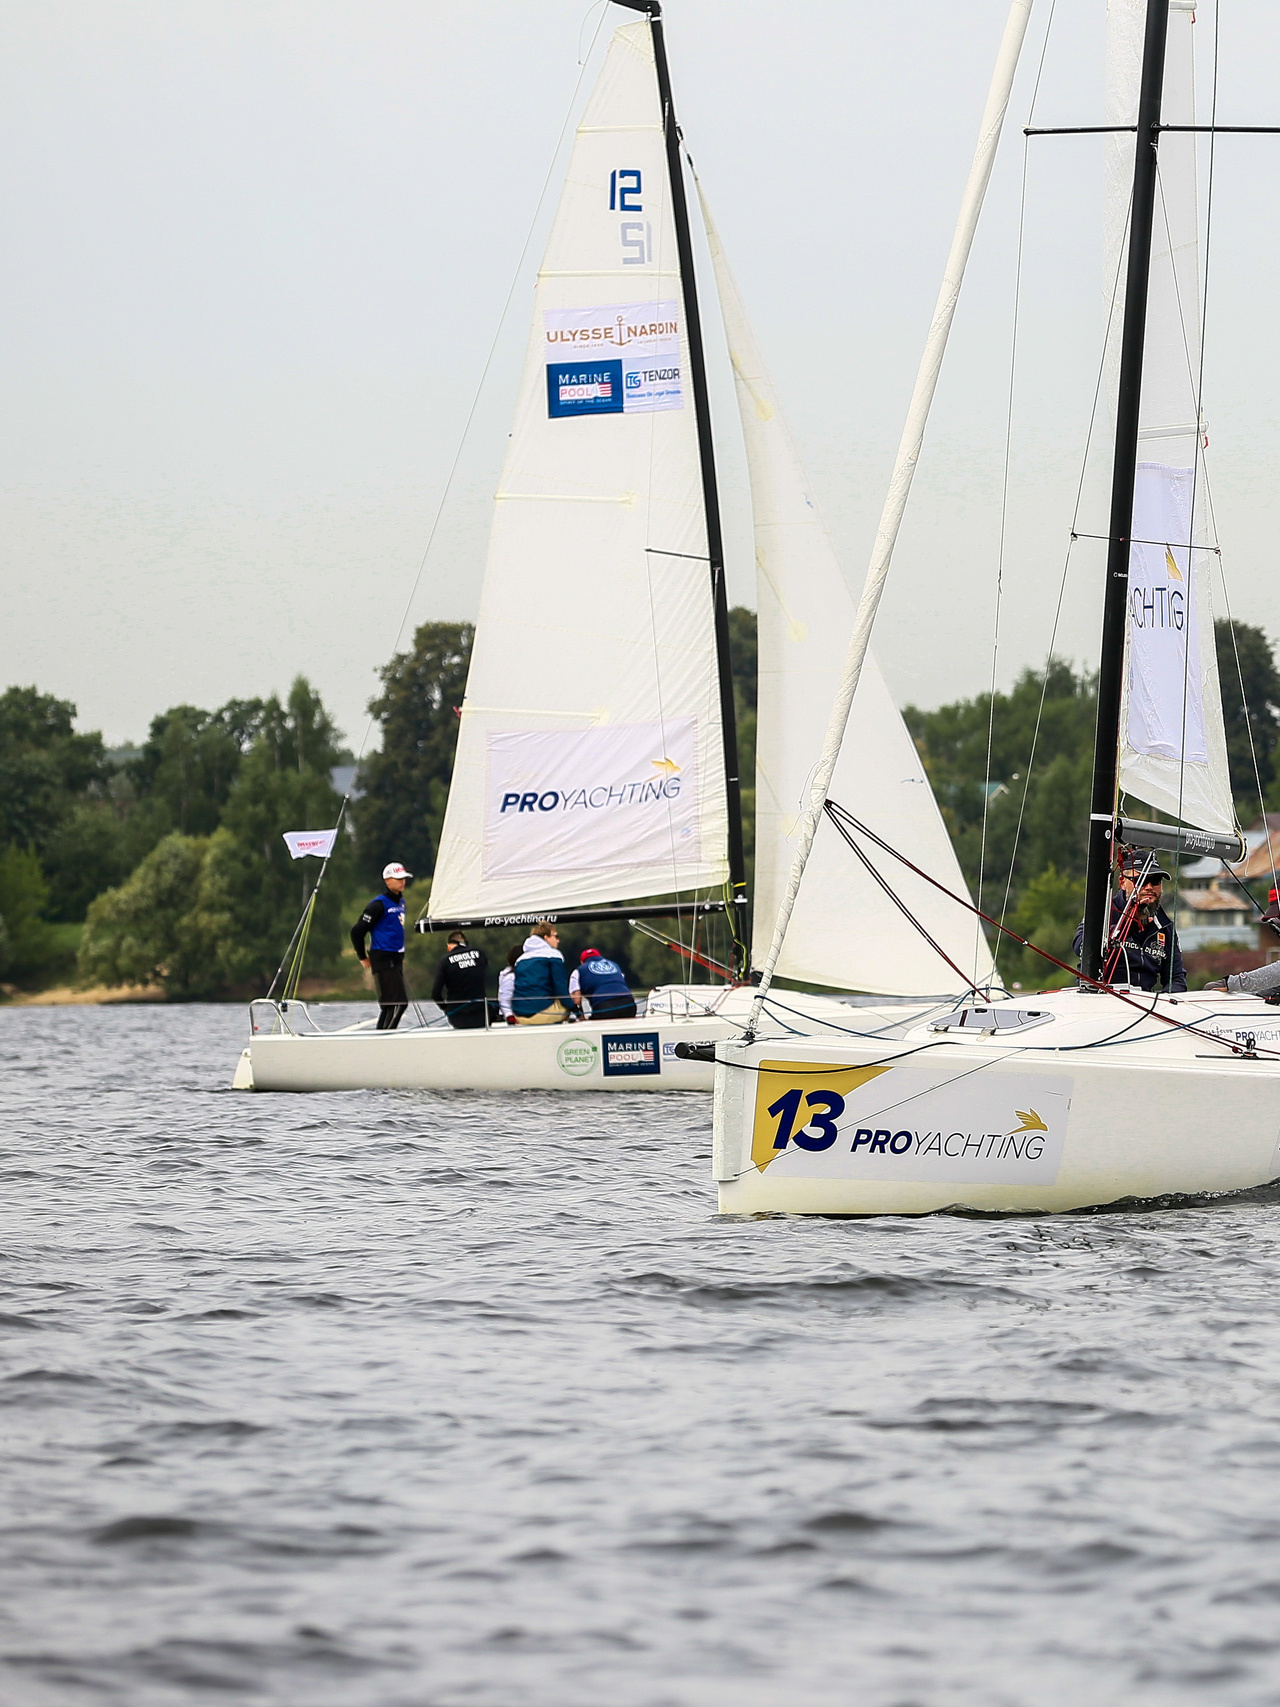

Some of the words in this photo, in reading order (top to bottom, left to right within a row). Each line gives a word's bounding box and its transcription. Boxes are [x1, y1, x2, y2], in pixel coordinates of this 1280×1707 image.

[609, 169, 643, 212] 12
[546, 326, 614, 343] ULYSSE
[627, 321, 678, 338] NARDIN
[559, 372, 612, 385] MARINE
[642, 368, 680, 382] TENZOR
[560, 388, 591, 398] POOL
[499, 777, 682, 814] PROYACHTING
[448, 950, 480, 964] KOROLEV
[458, 959, 477, 969] DIMA
[564, 1048, 590, 1056] GREEN
[608, 1041, 654, 1051] MARINE
[565, 1056, 594, 1064] PLANET
[610, 1053, 637, 1062] POOL
[767, 1088, 846, 1152] 13
[850, 1129, 1047, 1160] PROYACHTING
